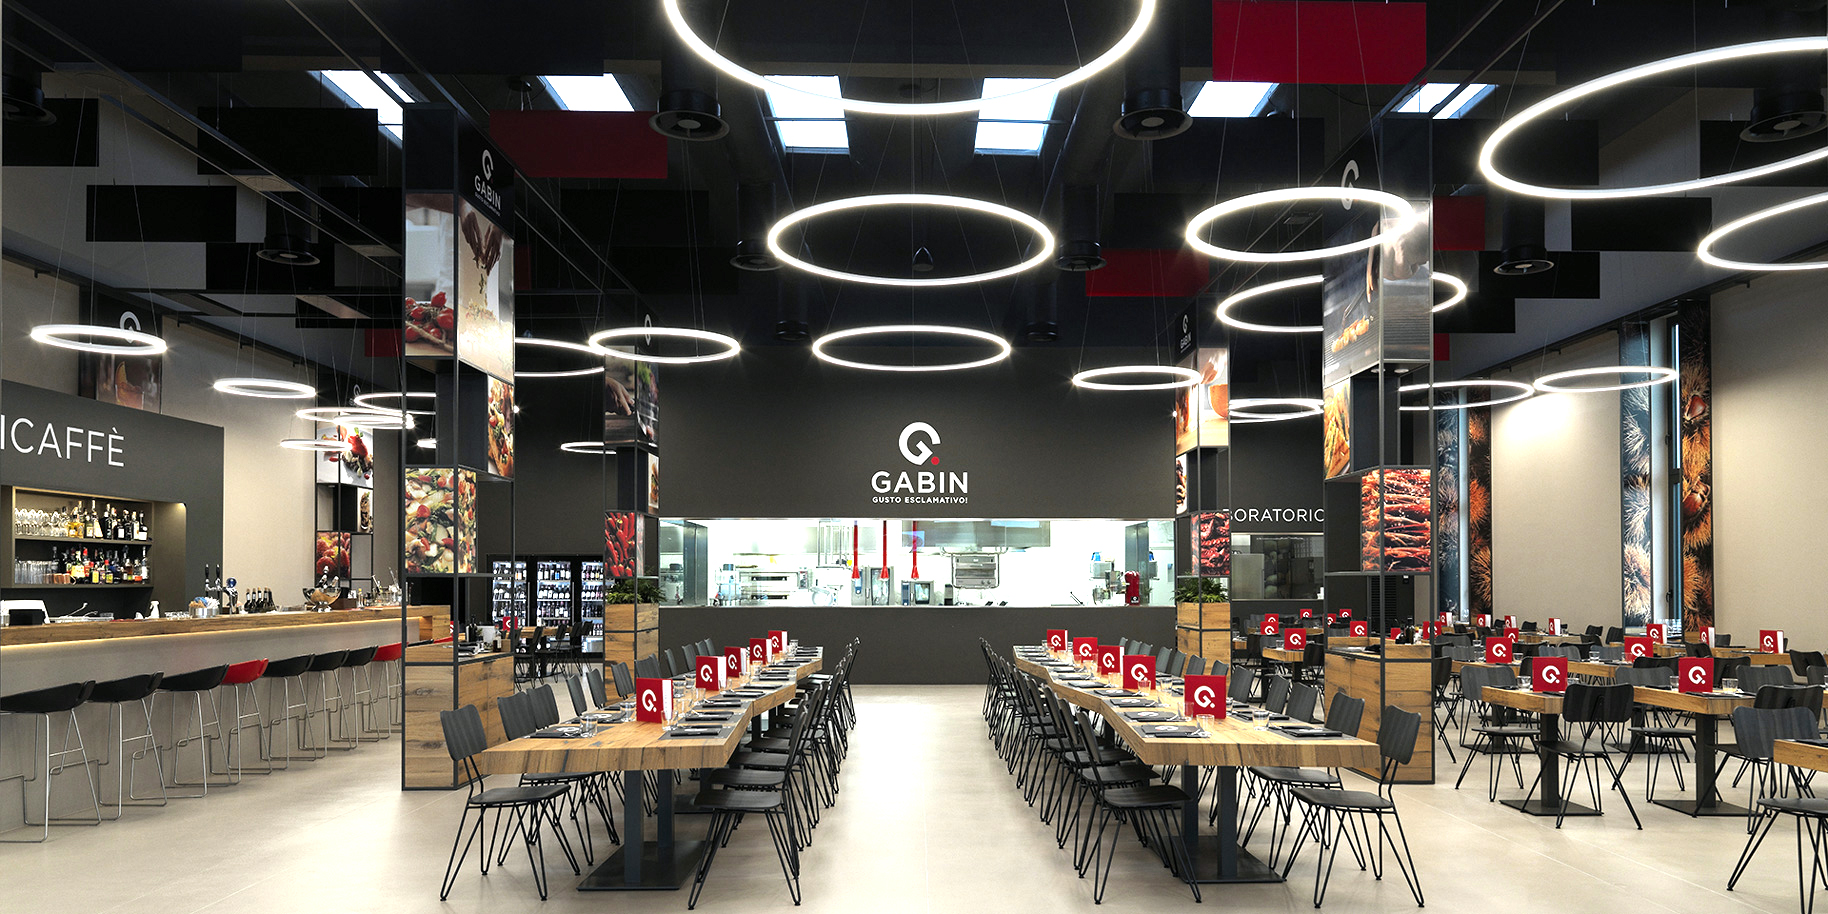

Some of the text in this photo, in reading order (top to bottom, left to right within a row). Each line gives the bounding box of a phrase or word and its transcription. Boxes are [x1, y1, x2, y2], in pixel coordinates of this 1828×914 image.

[474, 175, 501, 211] GABIN
[871, 471, 968, 494] GABIN
[872, 496, 968, 504] GUSTO ESCLAMATIVO!
